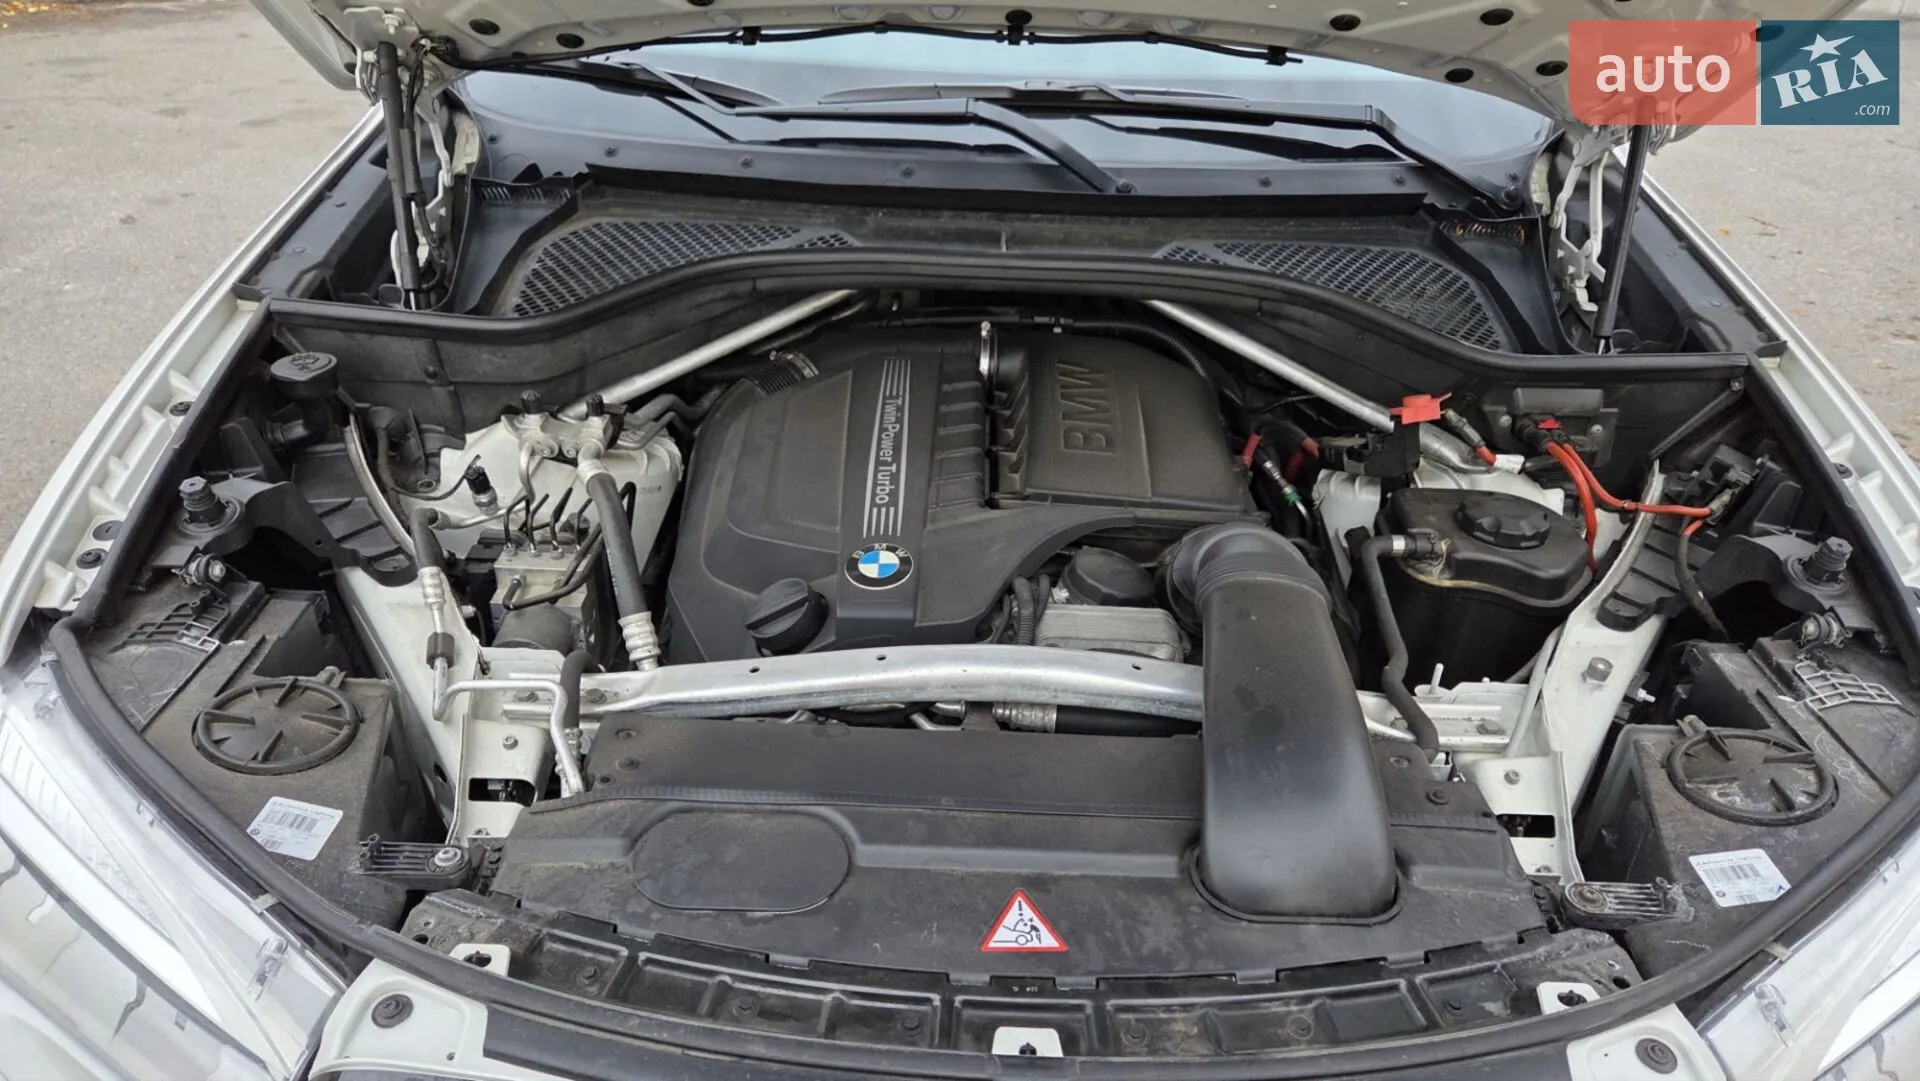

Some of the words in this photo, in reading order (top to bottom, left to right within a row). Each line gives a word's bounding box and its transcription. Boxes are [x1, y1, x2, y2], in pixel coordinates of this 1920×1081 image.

[879, 397, 903, 463] TwinPower
[1056, 361, 1116, 456] BMW
[875, 463, 897, 504] Turbo
